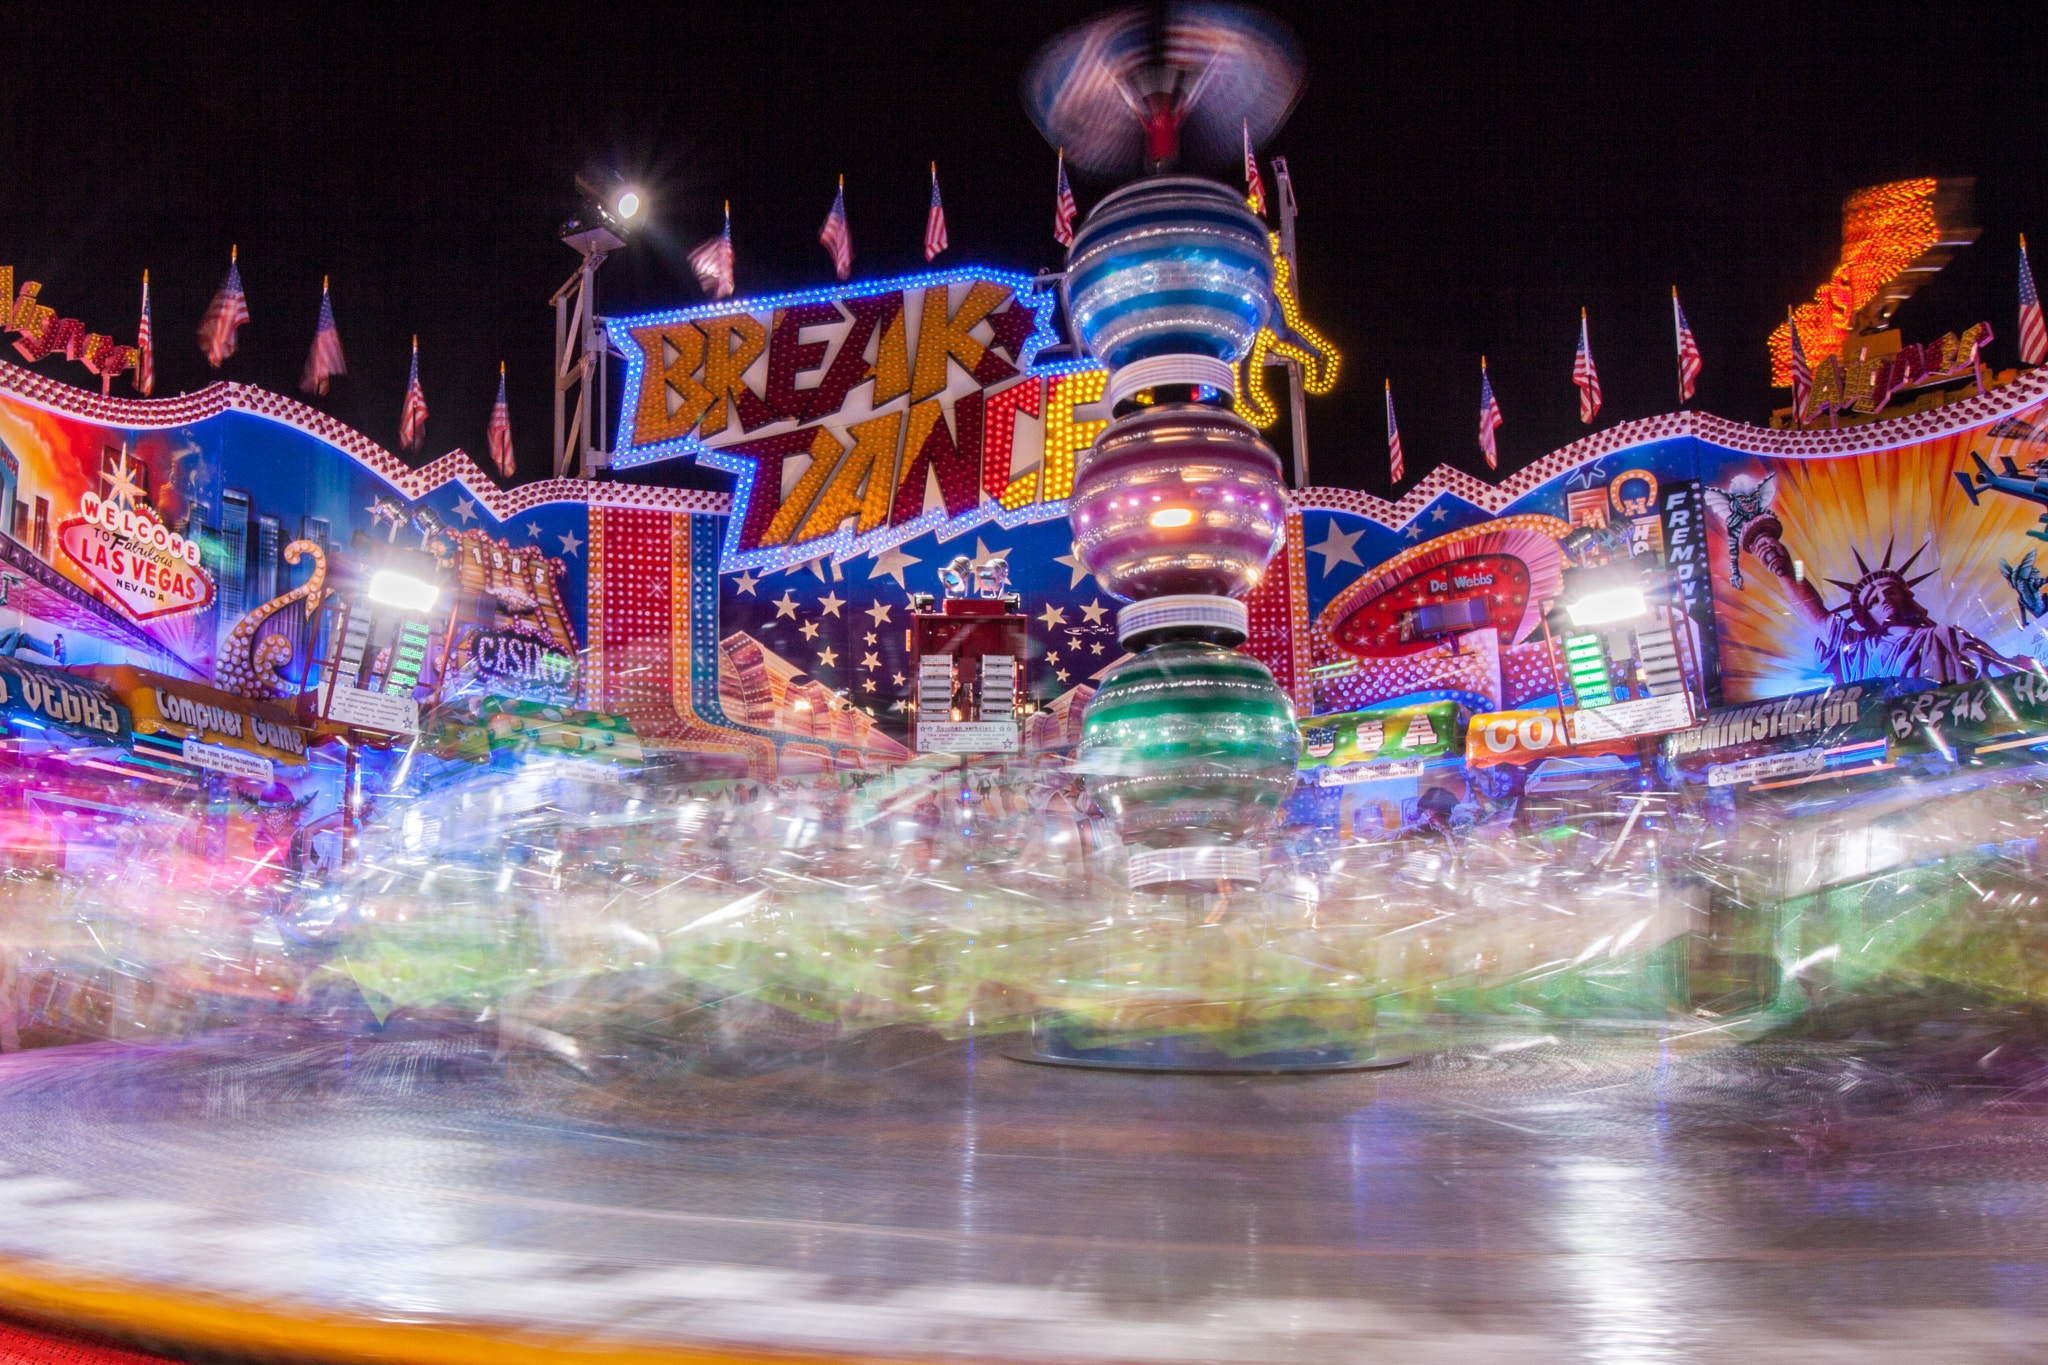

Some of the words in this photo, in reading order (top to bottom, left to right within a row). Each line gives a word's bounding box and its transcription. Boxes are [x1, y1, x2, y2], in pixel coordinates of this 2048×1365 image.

[628, 281, 1040, 448] BREAK
[717, 368, 1112, 555] DANCE
[83, 497, 196, 561] WELCOME
[94, 527, 110, 542] TO
[109, 532, 172, 568] Fabulous
[81, 538, 125, 575] LAS
[132, 553, 196, 601] VEGAS
[116, 578, 165, 602] NEVADA
[1430, 579, 1448, 592] De
[1454, 572, 1494, 588] Webbs
[478, 636, 566, 683] CASINO
[154, 685, 244, 739] Computer
[250, 713, 305, 755] Game
